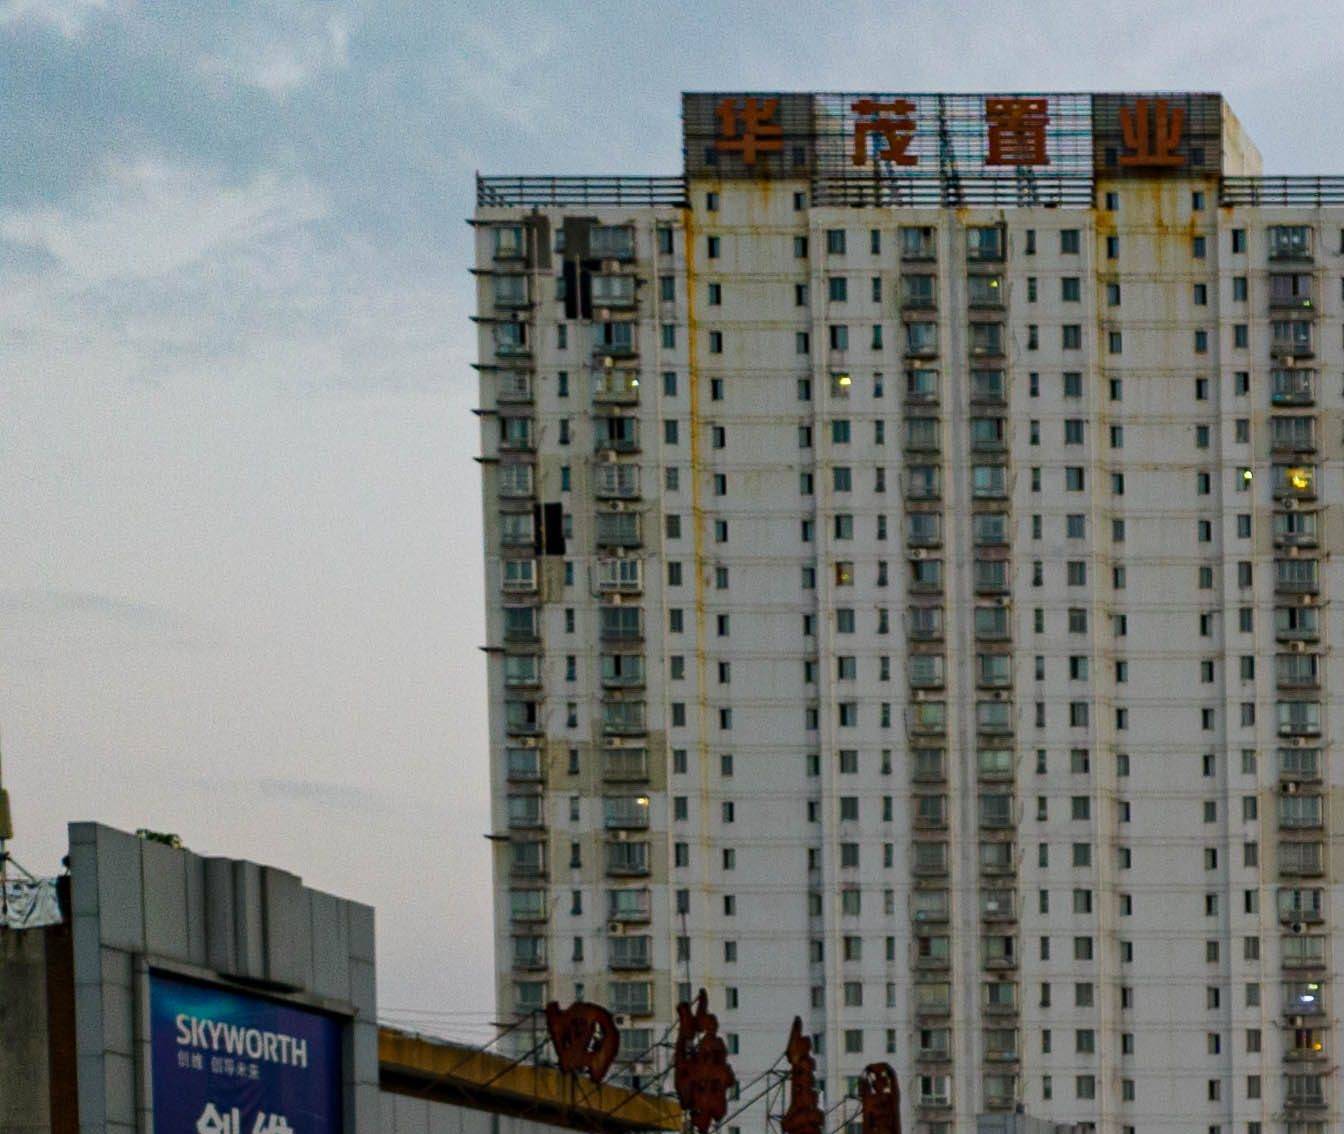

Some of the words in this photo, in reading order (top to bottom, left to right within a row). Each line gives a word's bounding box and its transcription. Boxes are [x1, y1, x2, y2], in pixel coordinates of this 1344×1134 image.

[715, 98, 1187, 167] 华茂置业
[176, 1013, 308, 1068] SKYWORTH
